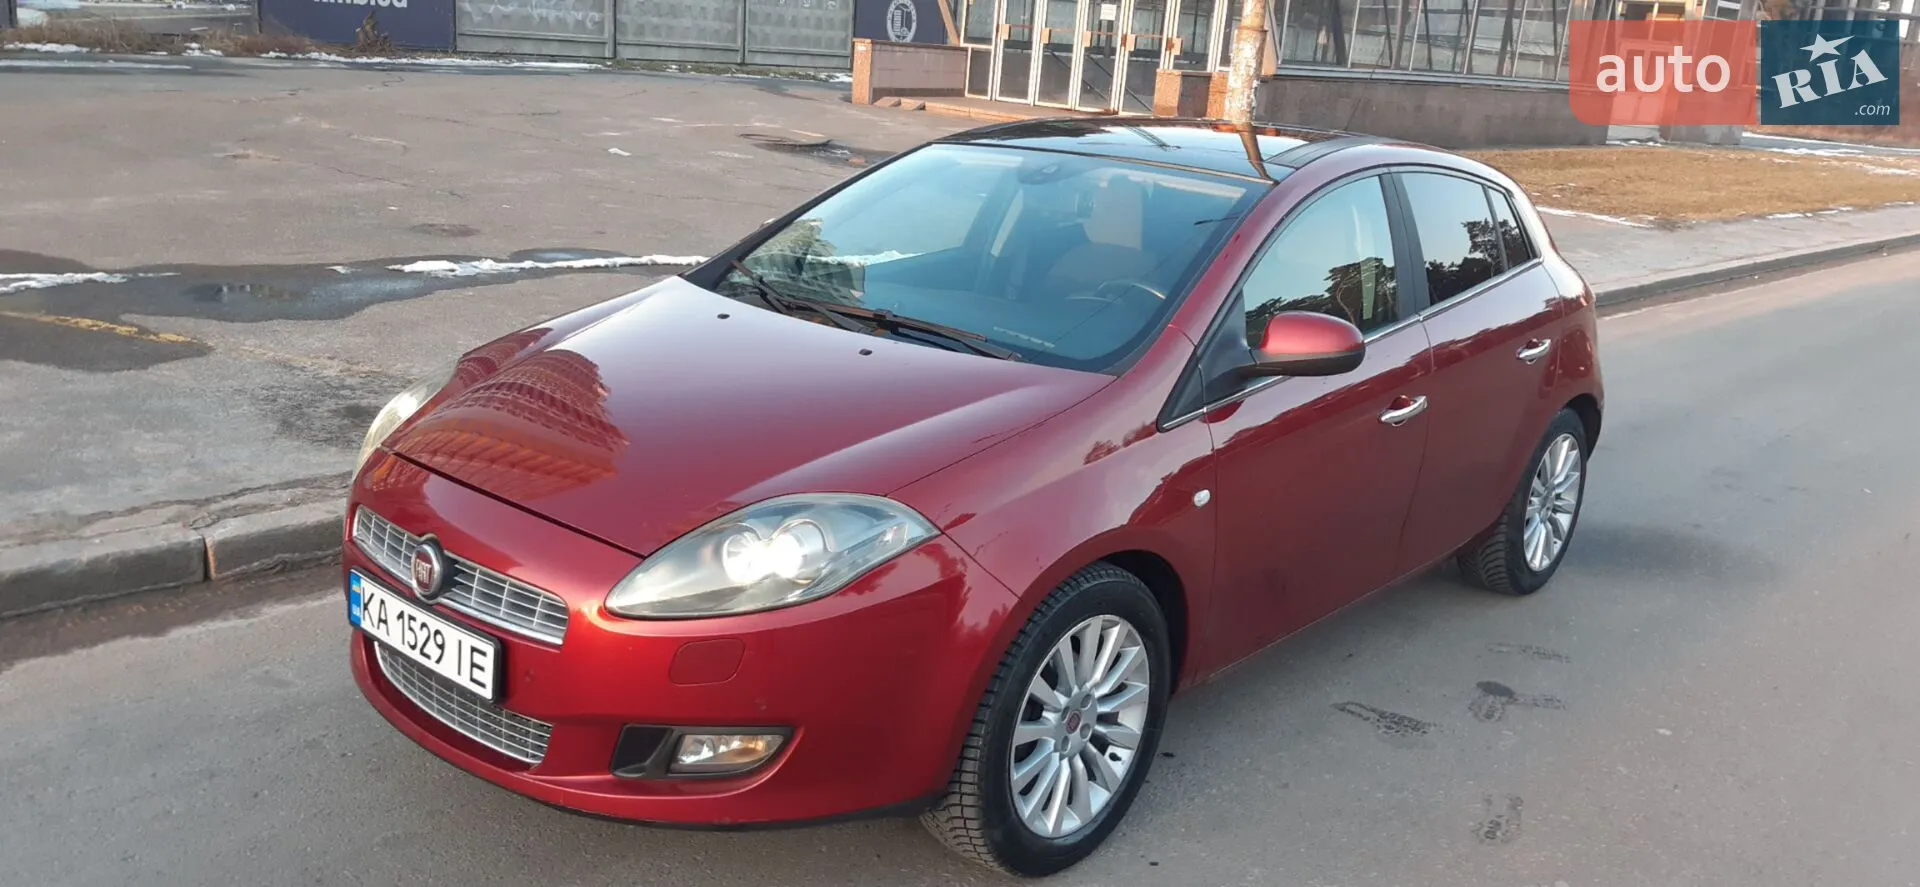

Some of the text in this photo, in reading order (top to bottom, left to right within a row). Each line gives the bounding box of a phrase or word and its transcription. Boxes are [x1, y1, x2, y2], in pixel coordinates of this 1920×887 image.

[415, 558, 432, 584] FIAT
[362, 587, 488, 689] KA 1529 IE
